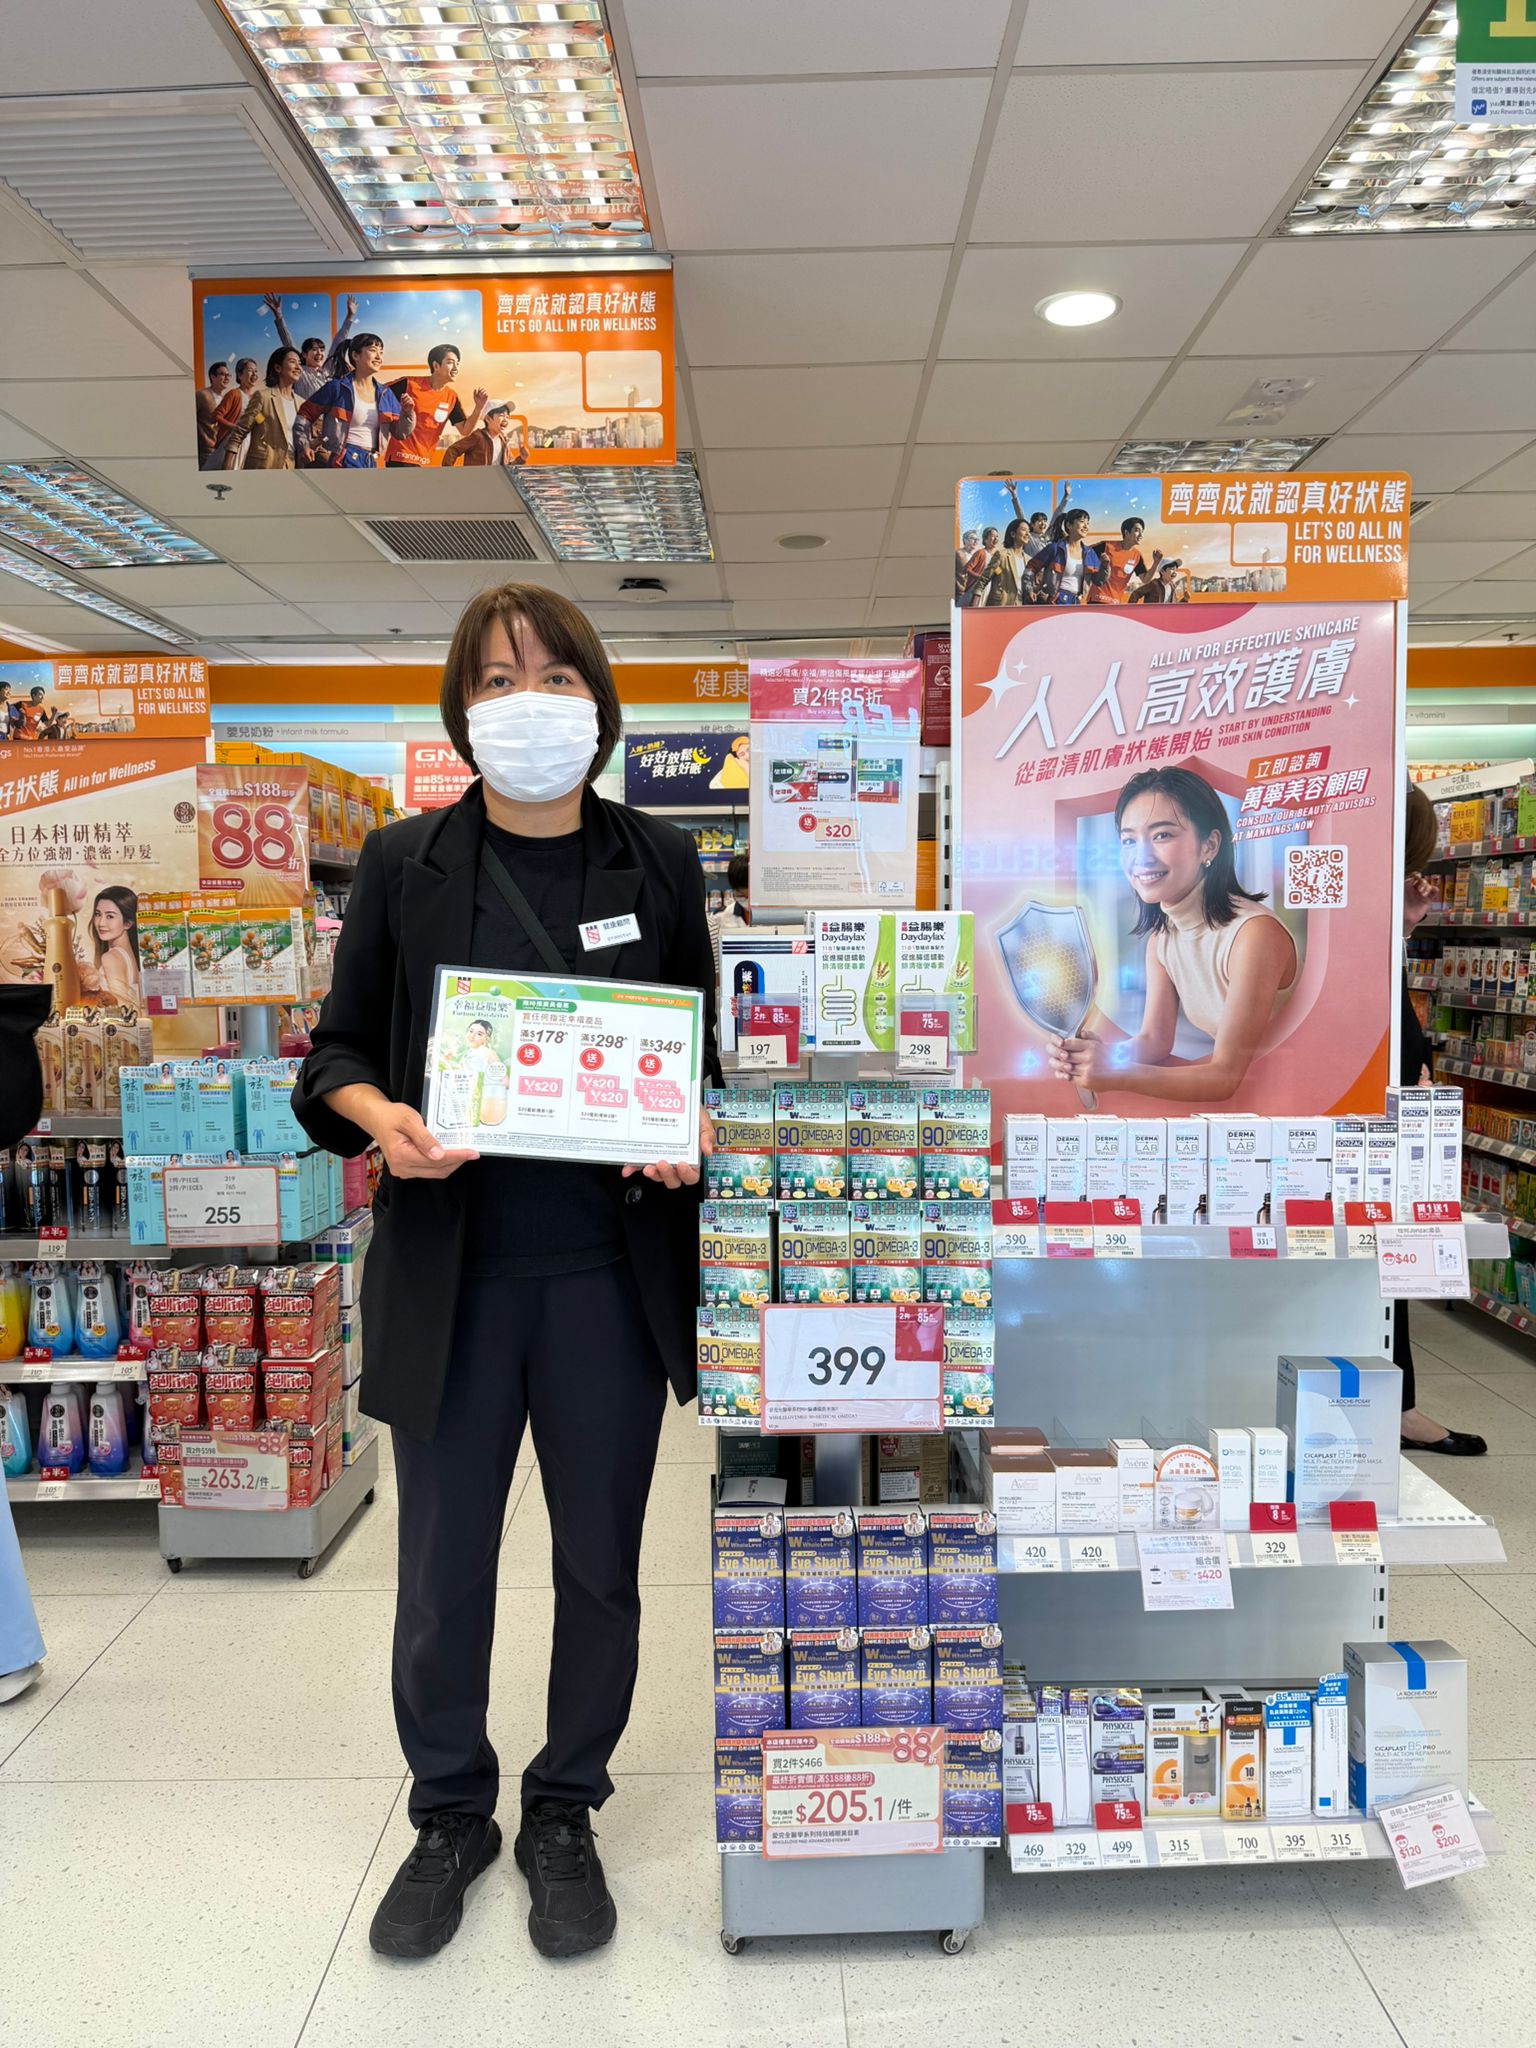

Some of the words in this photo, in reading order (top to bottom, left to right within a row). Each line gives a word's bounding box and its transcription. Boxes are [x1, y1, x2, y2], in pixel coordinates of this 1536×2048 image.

[497, 291, 657, 315] 齊齊成就認真好狀態
[497, 319, 525, 333] LET'S
[529, 319, 542, 332] GO
[545, 319, 564, 332] ALL
[567, 319, 577, 332] IN
[581, 318, 600, 332] FOR
[603, 317, 657, 331] WELLNESS
[1168, 481, 1407, 516] 齊齊成就認真好狀態
[1295, 522, 1332, 540] LET'S
[1336, 521, 1354, 539] GO
[1359, 521, 1384, 539] ALL
[1388, 521, 1402, 539] IN
[1295, 546, 1322, 564] FOR
[1326, 545, 1402, 563] WELLNESS
[1150, 653, 1176, 669] ALL
[1178, 650, 1193, 663] IN
[1196, 643, 1222, 660] FOR
[1224, 631, 1292, 656] EFFECTIVE
[1295, 616, 1360, 643] SKINCARE
[58, 662, 205, 685] 齊齊成就認真好狀態
[693, 669, 749, 697] 健康
[138, 688, 162, 700] LET'S
[164, 688, 175, 699] GO
[177, 687, 194, 699] ALL
[196, 687, 205, 699] IN
[995, 638, 1355, 760] 人人高效護膚
[138, 703, 156, 715] FOR
[158, 702, 206, 714] WELLNESS
[1218, 721, 1247, 735] START
[1248, 719, 1261, 731] BY
[1261, 705, 1332, 728] UNDERSTANDING
[227, 727, 274, 738] 嬰兒奶粉
[281, 728, 303, 736] infant
[1218, 735, 1240, 748] YOUR
[1242, 732, 1263, 744] SKIN
[1264, 722, 1311, 741] CONDITION
[1014, 728, 1213, 787] 從認清肌膚狀態開始
[1254, 752, 1323, 779] 立即諮詢
[64, 776, 77, 793] All
[80, 775, 90, 789] in
[91, 772, 107, 786] for
[109, 759, 157, 781] Wellness
[1241, 767, 1371, 813] 萬寧美容顧問
[1236, 814, 1275, 828] CONSULT
[1277, 811, 1296, 822] OUR
[1297, 803, 1331, 818] BEAUTY
[1333, 797, 1376, 811] ADVISORS
[11, 822, 134, 845] 日本科研精萃
[210, 802, 295, 870] 88
[825, 825, 852, 838] $20
[1232, 831, 1243, 842] AT
[1245, 824, 1292, 840] MANNINGS
[1294, 820, 1315, 831] NOW
[829, 921, 865, 932] 益腸樂
[909, 921, 944, 932] 益腸樂
[822, 934, 865, 943] Daydaylax
[901, 933, 945, 943] Daydaylax
[772, 1013, 784, 1024] 85
[922, 1018, 934, 1029] 75
[750, 1044, 770, 1055] 197
[909, 1044, 932, 1055] 298
[728, 1128, 770, 1140] OMEGA-3
[801, 1129, 843, 1141] OMEGA-3
[873, 1129, 915, 1141] OMEGA-3
[946, 1129, 988, 1141] OMEGA-3
[1016, 1144, 1039, 1153] LAB
[1057, 1144, 1080, 1153] LAB
[1096, 1144, 1118, 1153] LAB
[1012, 1206, 1024, 1217] 85
[1114, 1205, 1125, 1216] 85
[1366, 1209, 1377, 1219] 75
[1417, 1204, 1449, 1213] 買1送1
[205, 1206, 241, 1225] 255
[1005, 1234, 1027, 1245] 390
[1105, 1234, 1126, 1245] 390
[1395, 1252, 1417, 1265] $40
[917, 1312, 929, 1323] 85
[807, 1346, 886, 1386] 399
[258, 1435, 282, 1454] 88
[1338, 1450, 1352, 1459] B5
[1123, 1458, 1149, 1467] Avène
[1273, 1510, 1278, 1520] 8
[1025, 1546, 1046, 1558] 420
[1081, 1546, 1103, 1558] 420
[1265, 1543, 1286, 1553] 329
[718, 1557, 740, 1571] Eye
[742, 1556, 778, 1571] Sharp
[791, 1556, 812, 1570] Eye
[815, 1556, 850, 1571] Sharp
[863, 1556, 884, 1569] Eye
[886, 1555, 922, 1570] Sharp
[934, 1554, 956, 1568] Eye
[959, 1553, 994, 1568] Sharp
[1197, 1569, 1222, 1580] $420
[1275, 1693, 1288, 1701] B5
[893, 1732, 931, 1763] 88
[772, 1758, 823, 1770] 買2件$466
[1171, 1770, 1177, 1779] 5
[1245, 1767, 1254, 1777] 10
[1026, 1810, 1038, 1821] 75
[1115, 1809, 1126, 1820] 75
[1169, 1839, 1190, 1851] 315
[1238, 1837, 1258, 1849] 700
[1285, 1835, 1306, 1847] 395
[1331, 1834, 1351, 1846] 315
[1436, 1834, 1461, 1849] $200
[1024, 1845, 1044, 1856] 469
[1066, 1843, 1087, 1855] 329
[1112, 1841, 1133, 1853] 499
[1399, 1845, 1422, 1860] $120
